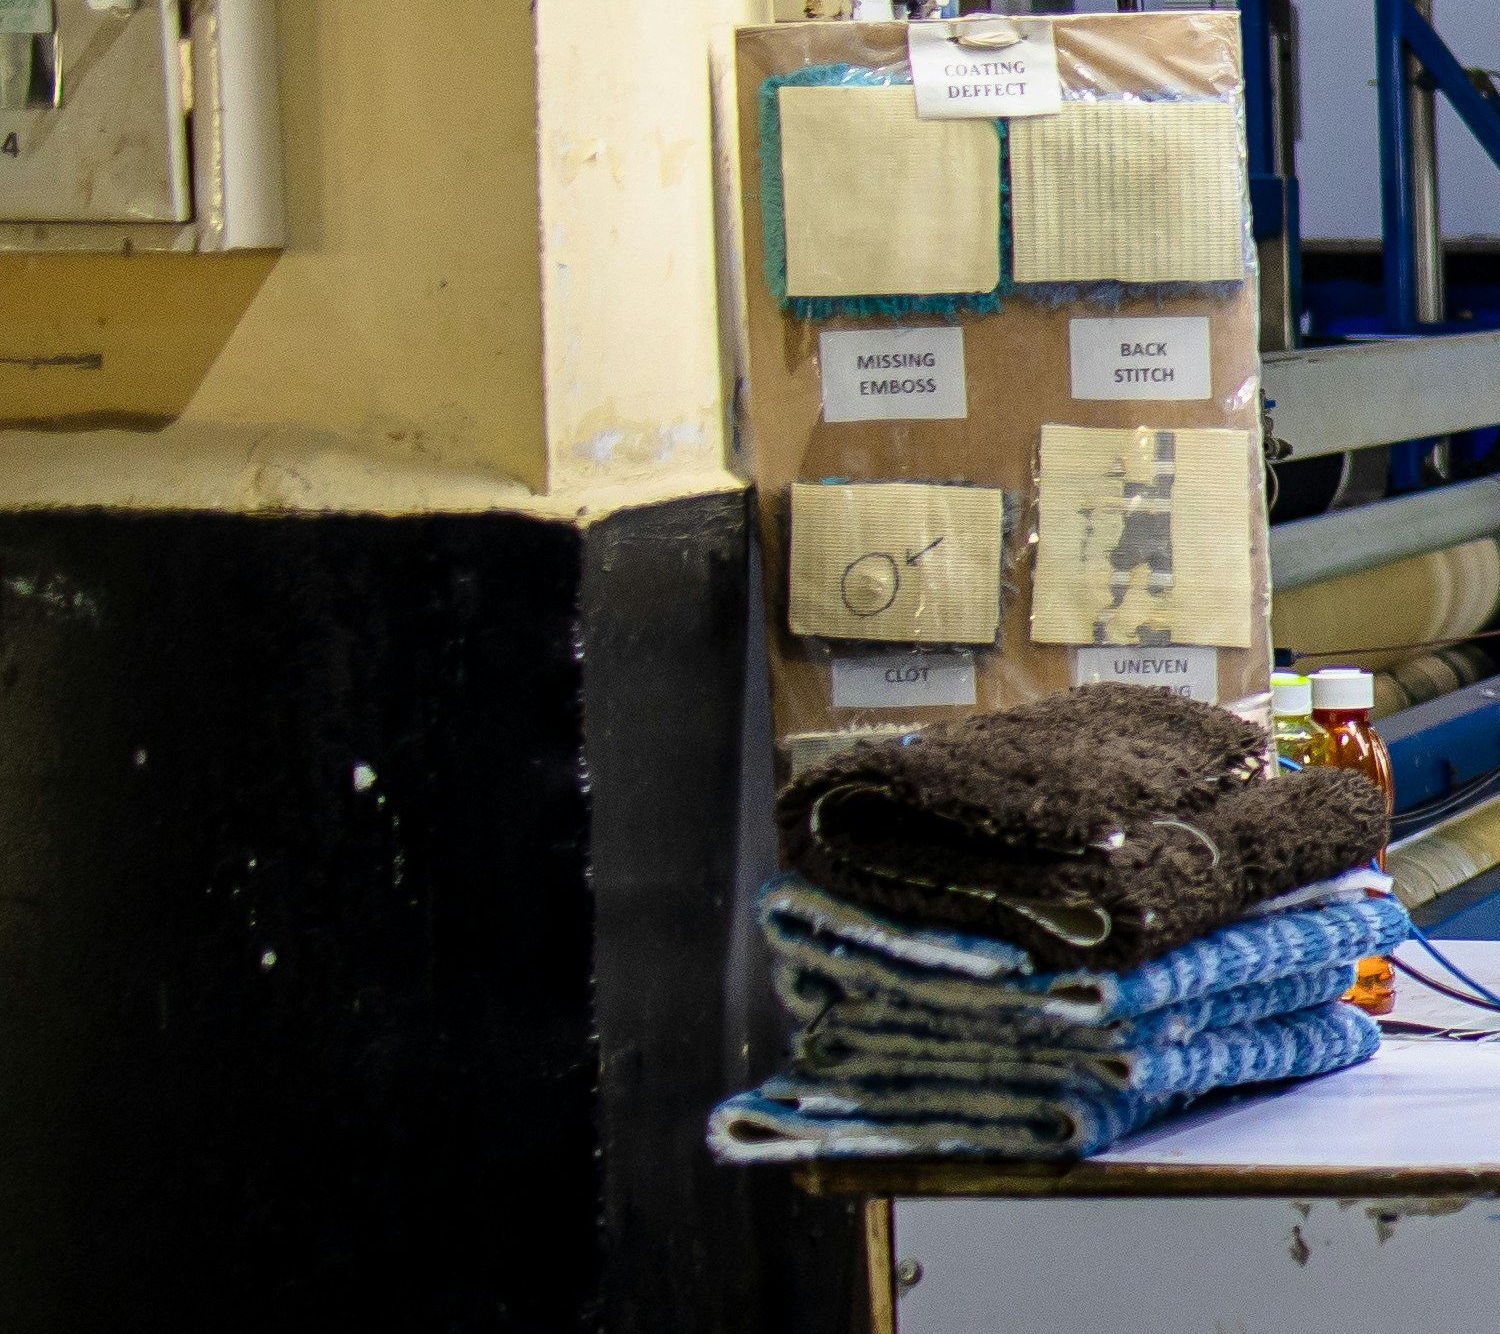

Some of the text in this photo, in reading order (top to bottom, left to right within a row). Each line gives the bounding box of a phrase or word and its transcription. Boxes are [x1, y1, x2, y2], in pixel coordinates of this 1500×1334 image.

[944, 60, 1026, 77] COATING
[947, 82, 1027, 99] DEFFECT
[1120, 342, 1168, 357] BACK
[856, 352, 936, 370] MISSING
[1114, 367, 1174, 383] STITCH
[859, 378, 937, 396] EMBOSS
[884, 666, 930, 683] CLOT
[1113, 658, 1188, 675] UNEVEN
